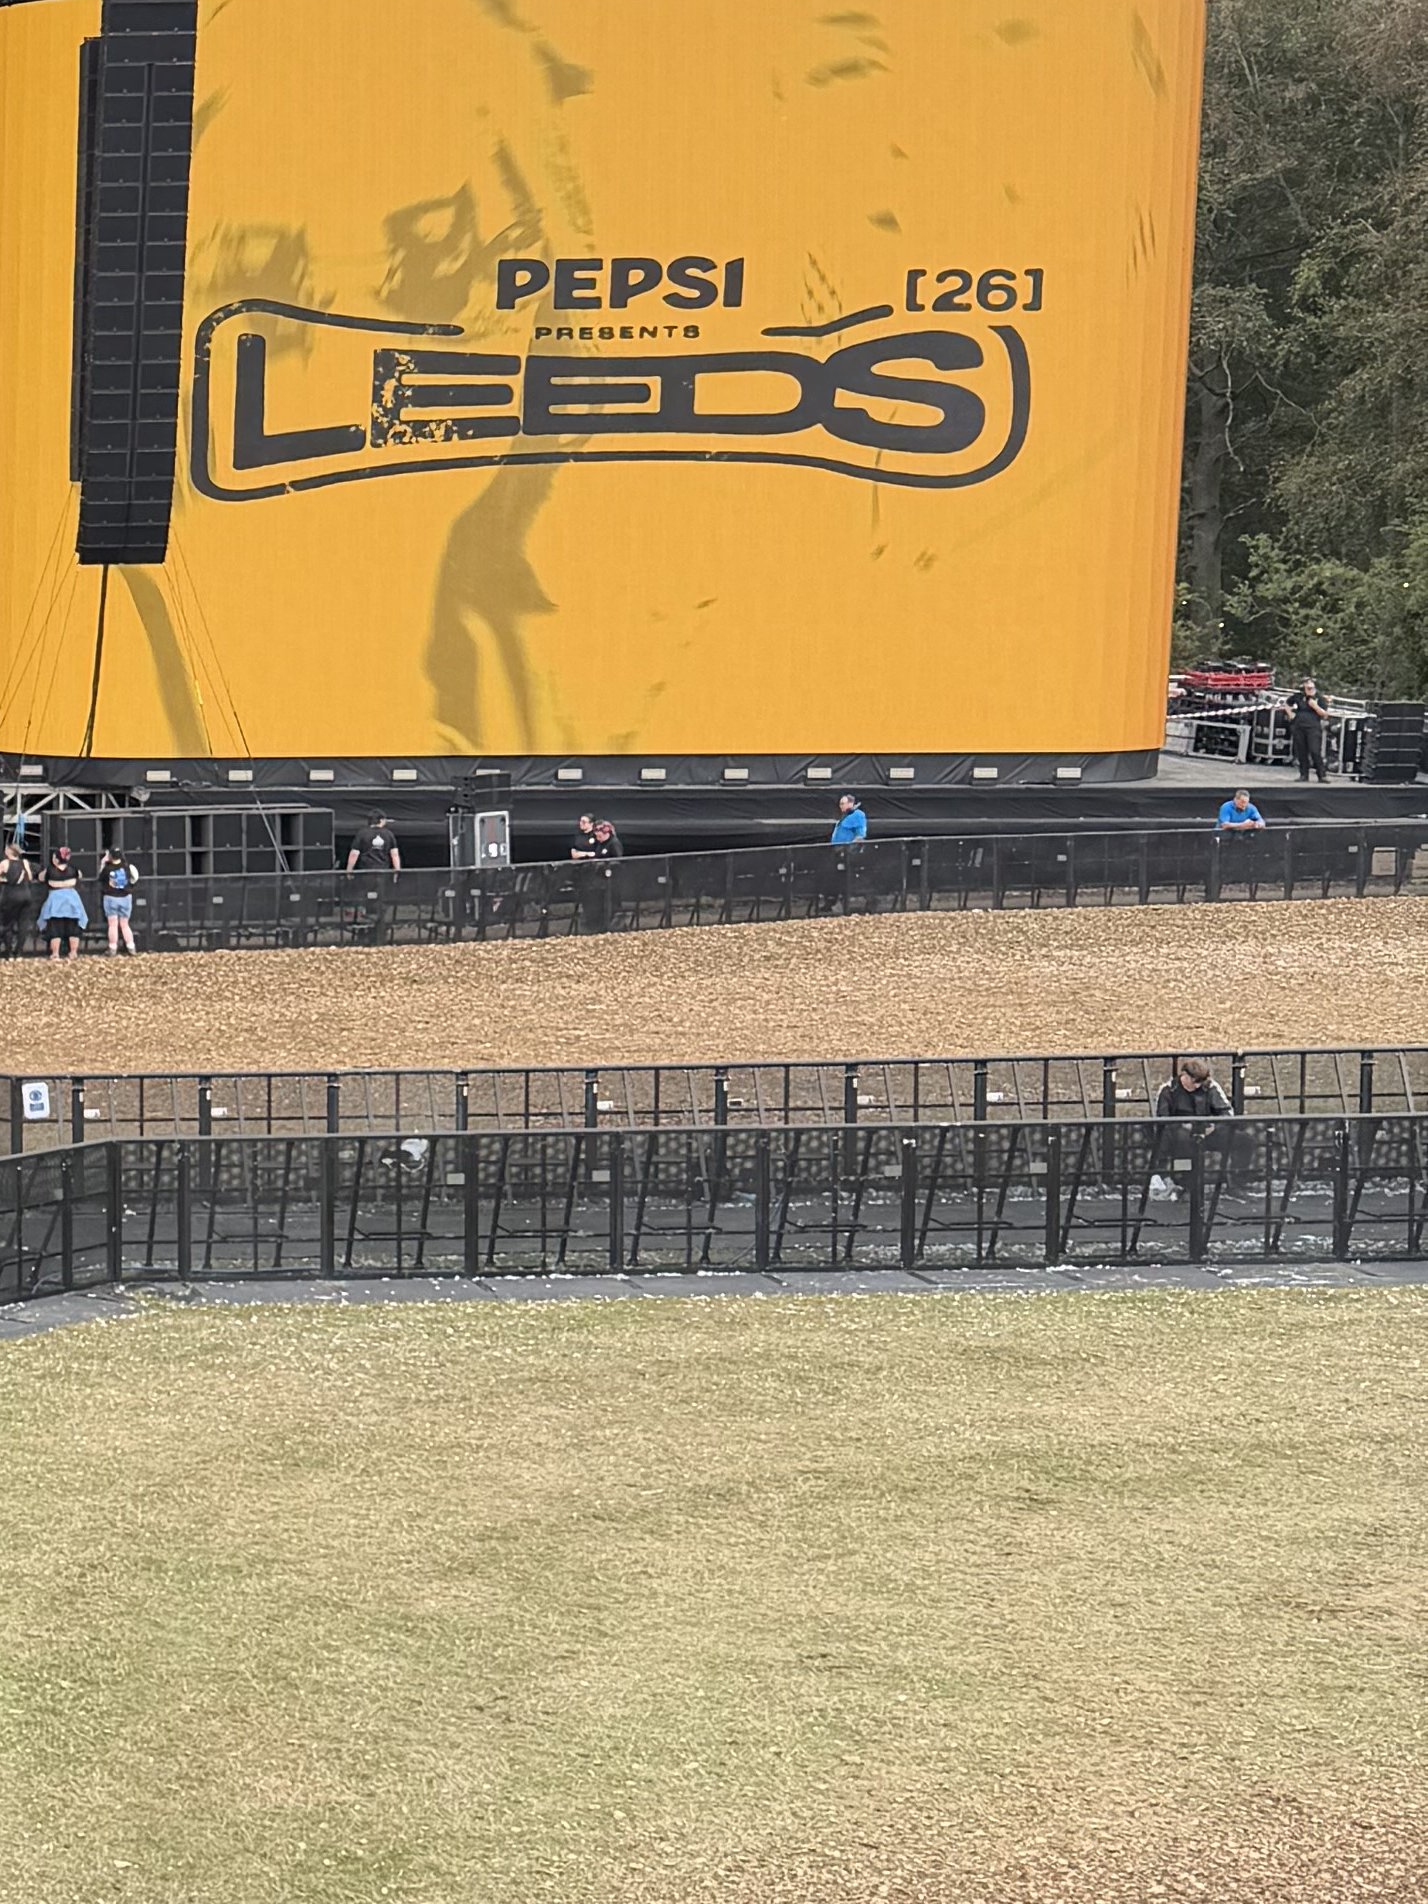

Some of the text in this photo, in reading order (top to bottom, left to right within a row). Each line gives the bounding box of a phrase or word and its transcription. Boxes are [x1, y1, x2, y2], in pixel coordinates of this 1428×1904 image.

[496, 256, 745, 310] PEPSI
[906, 268, 1044, 313] [26]
[535, 325, 700, 341] PRESENTS
[233, 331, 985, 470] LEEDS
